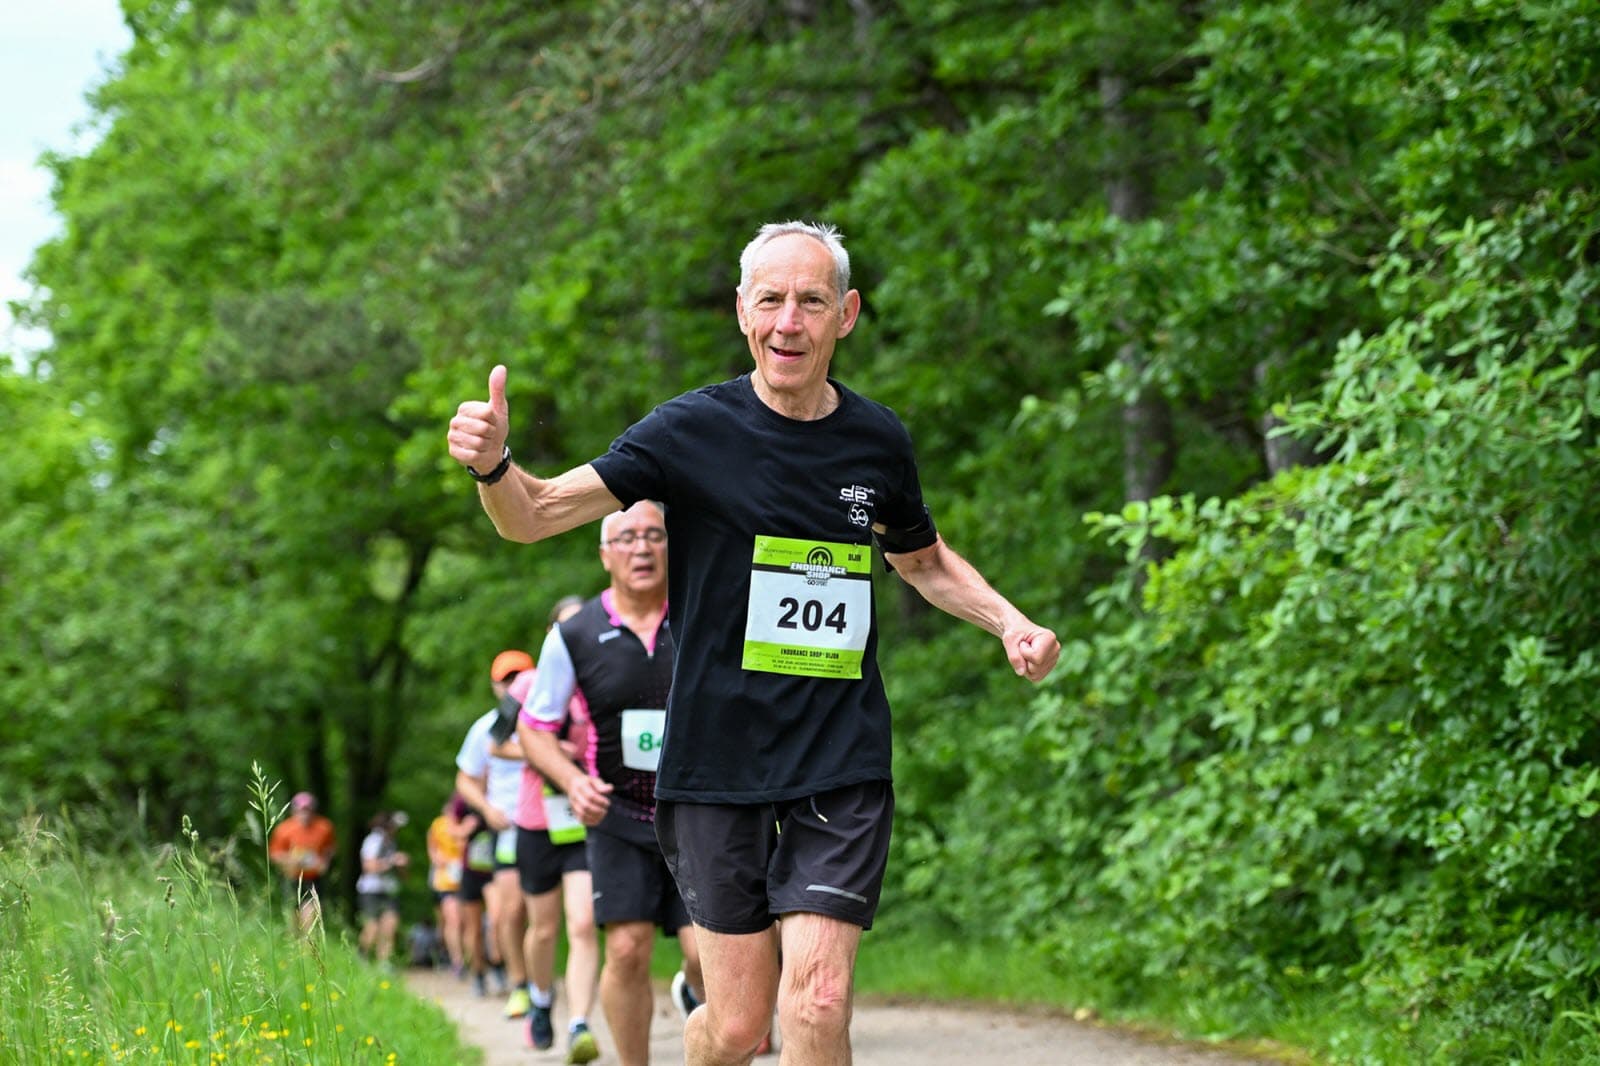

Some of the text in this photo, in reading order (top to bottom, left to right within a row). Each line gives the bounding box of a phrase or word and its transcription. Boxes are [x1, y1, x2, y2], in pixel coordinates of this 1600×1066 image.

[790, 561, 847, 575] ENDURANCE
[806, 571, 830, 579] SHOP
[777, 597, 847, 634] 204
